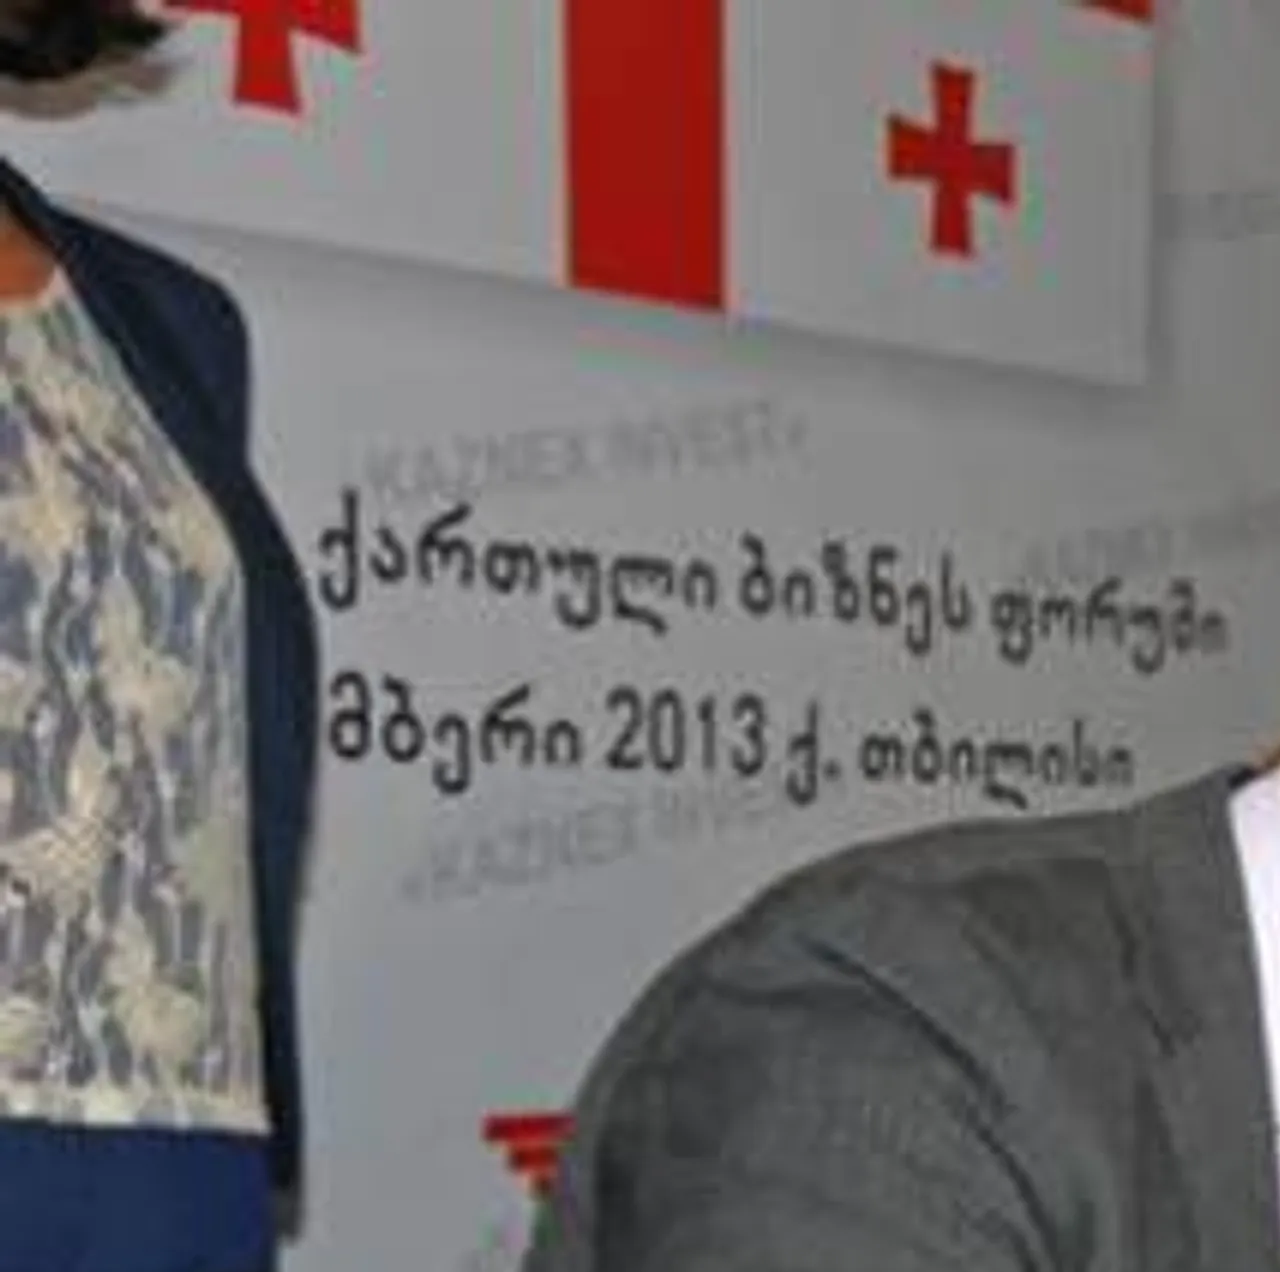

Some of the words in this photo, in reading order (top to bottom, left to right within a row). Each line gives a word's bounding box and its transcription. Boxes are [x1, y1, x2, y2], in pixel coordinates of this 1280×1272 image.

[318, 489, 718, 634] ქართული
[733, 534, 972, 664] ბიზნეს
[990, 579, 1231, 675] ფორუმი
[605, 686, 767, 778] 2013
[858, 708, 1134, 810] თბილისი
